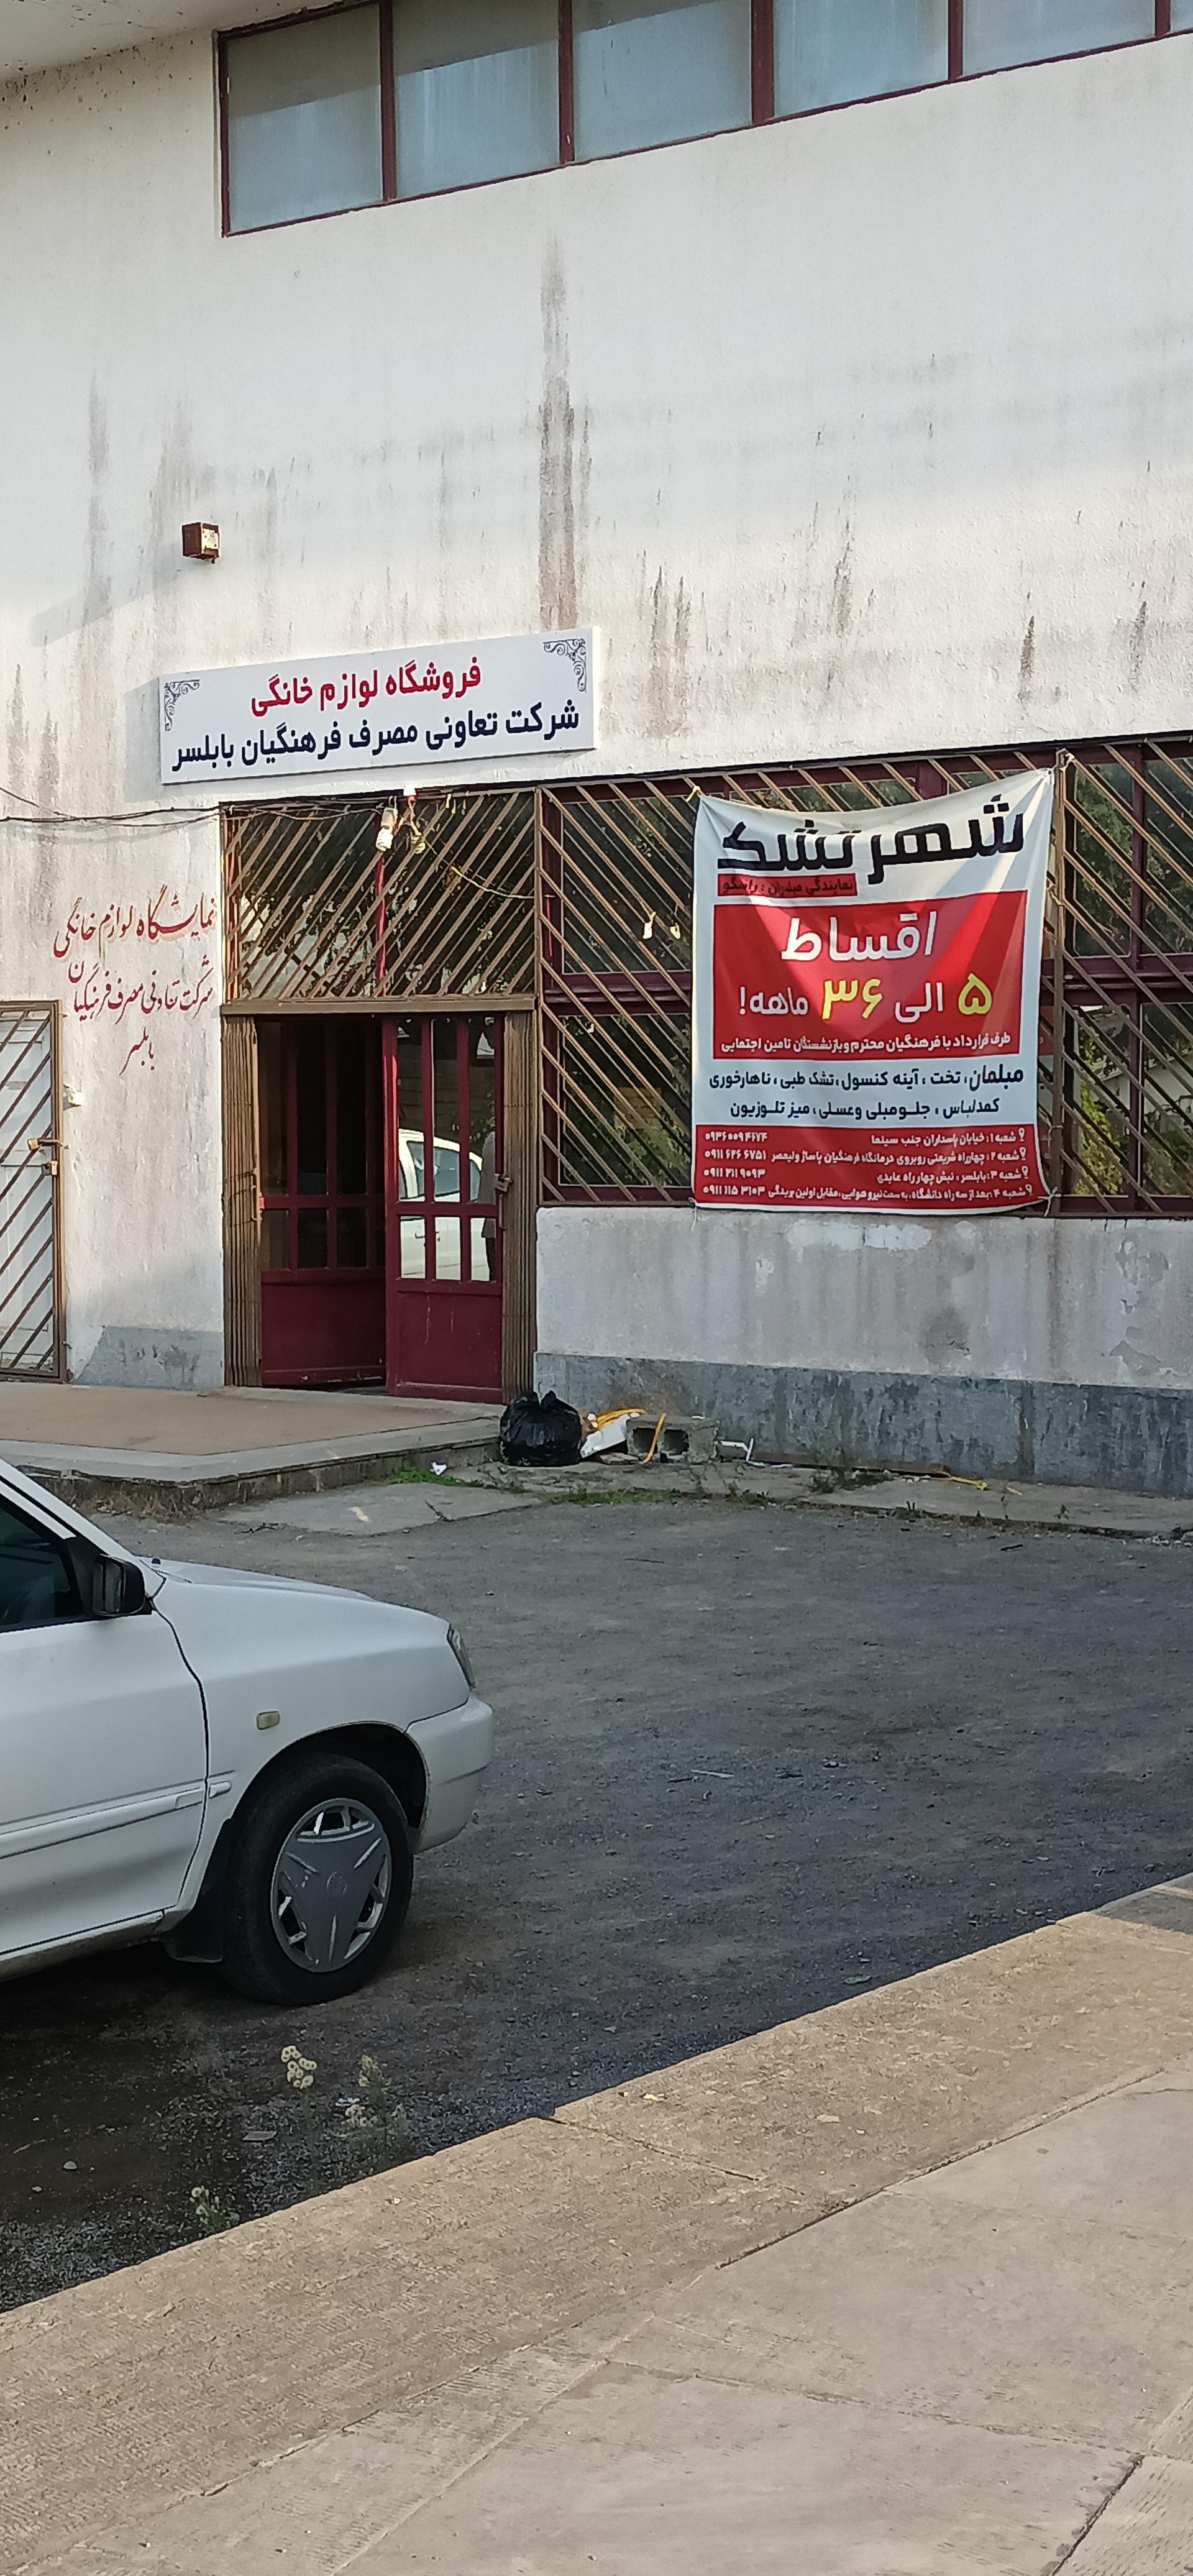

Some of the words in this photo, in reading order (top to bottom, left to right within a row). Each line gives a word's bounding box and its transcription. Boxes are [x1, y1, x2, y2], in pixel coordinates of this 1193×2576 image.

[386, 656, 481, 701] فروشگاه
[252, 674, 311, 717] خانگی
[320, 669, 378, 711] لوازم
[505, 699, 579, 739] شرکت
[349, 718, 418, 756] مصرف
[426, 710, 498, 749] تعاونی
[242, 721, 341, 765] فرهنگیان
[173, 734, 235, 771] بابلسر
[718, 820, 862, 871] تشک
[867, 794, 1023, 885] شهر
[136, 884, 216, 940] نمایشگاه
[53, 897, 96, 958] خانگی
[99, 904, 134, 960] لوازم
[781, 911, 938, 961] اقساط
[68, 960, 110, 1021] فرهنگیان
[140, 969, 180, 1014] تعاونی
[180, 954, 214, 1020] شرکت
[958, 973, 992, 1015] ۵
[107, 978, 144, 1025] مصرف
[822, 978, 884, 1020] ۳۶
[895, 982, 943, 1023] الی
[764, 1037, 792, 1053] تامین
[851, 1038, 885, 1053] محترم
[886, 1034, 941, 1053] فرهنگیان
[942, 1035, 951, 1051] با
[953, 1034, 989, 1050] قرارداد
[990, 1032, 1011, 1048] طرف
[119, 1026, 155, 1076] بابلسر
[809, 1071, 834, 1086] تشک
[893, 1068, 920, 1090] آینه
[788, 1102, 810, 1119] میز
[871, 1135, 898, 1147] سینما
[901, 1135, 921, 1147] جنب
[923, 1133, 959, 1148] پاسداران
[959, 1132, 985, 1145] خیابان
[995, 1130, 1017, 1145] شعبه
[771, 1150, 800, 1163] ولیعصر
[801, 1150, 823, 1165] پاساژ
[824, 1150, 860, 1164] فرهنگیان
[861, 1151, 895, 1166] درمانگاه
[896, 1155, 926, 1166] روبروی
[927, 1151, 956, 1166] شریعتی
[997, 1149, 1020, 1163] شعبه
[877, 1172, 901, 1184] عابدی
[936, 1170, 954, 1183] نبش
[999, 1168, 1022, 1182] شعبه
[767, 1184, 795, 1199] بریدگی
[795, 1187, 816, 1199] اولین
[816, 1187, 838, 1199] مقابل
[1002, 1186, 1026, 1200] شعبه
